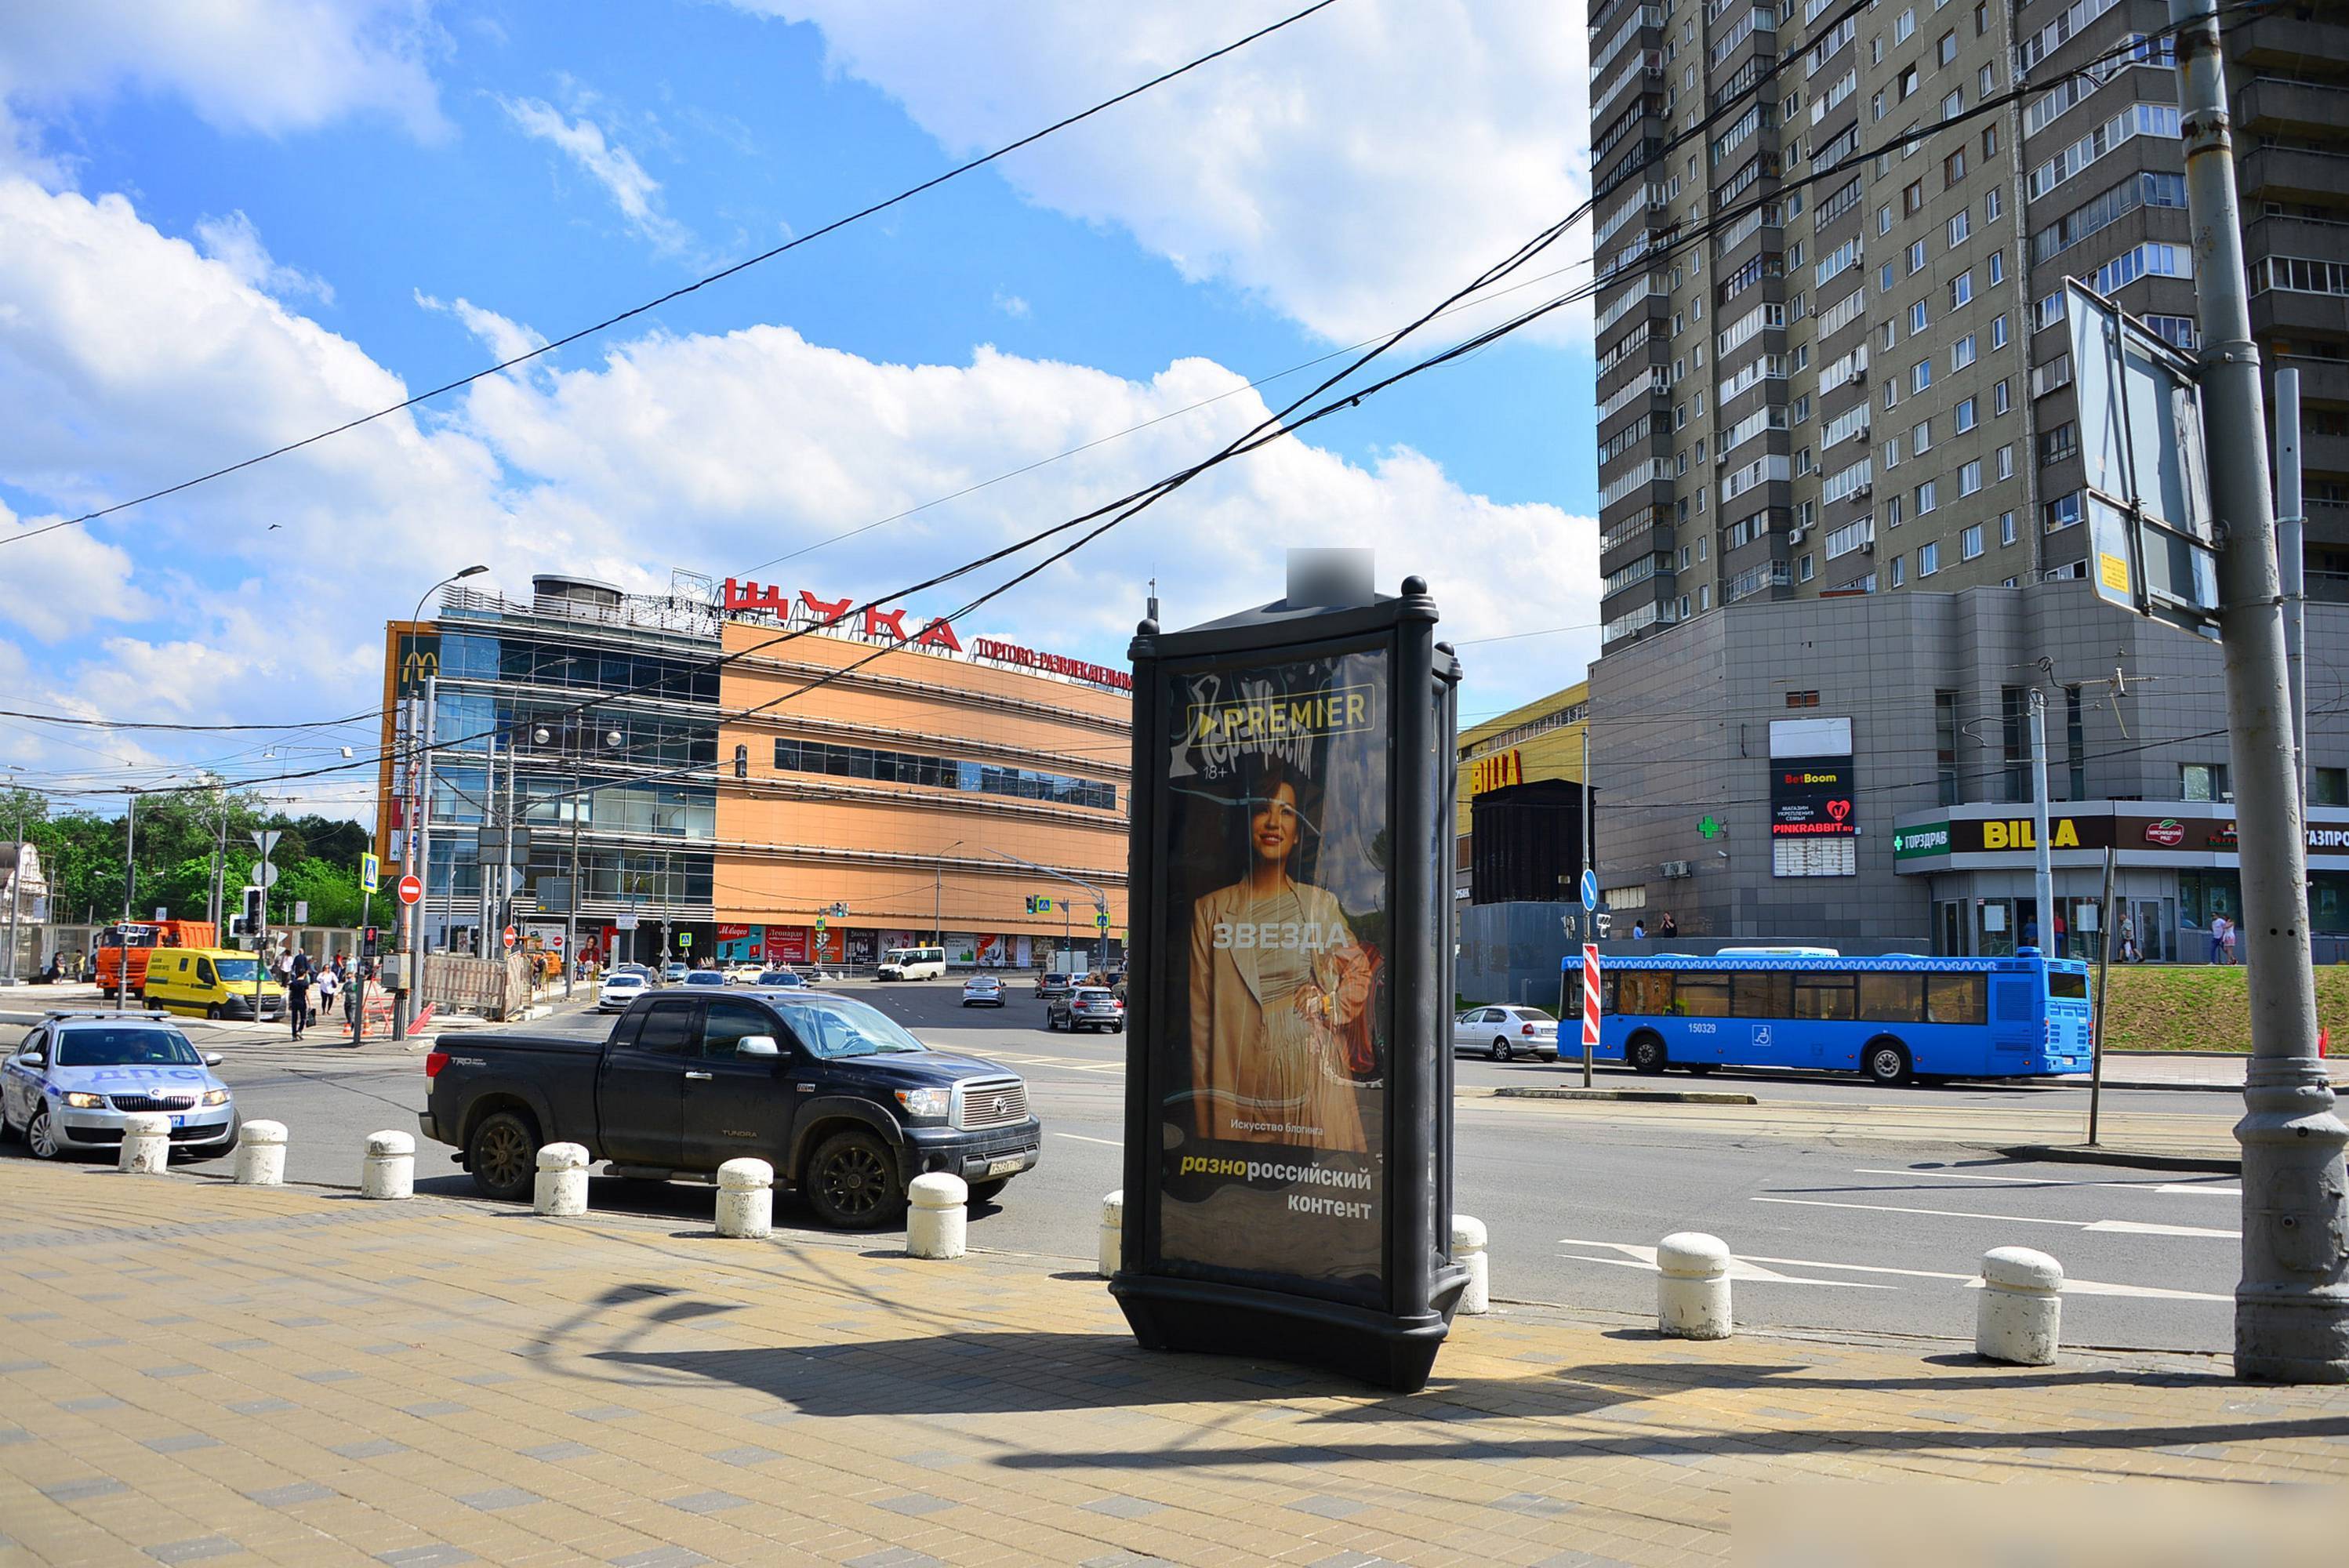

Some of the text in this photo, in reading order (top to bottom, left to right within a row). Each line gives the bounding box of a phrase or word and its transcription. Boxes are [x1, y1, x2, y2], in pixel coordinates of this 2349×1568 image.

[724, 577, 962, 652] ЩУКА
[1224, 693, 1365, 738] PREMIER
[1203, 765, 1229, 780] 18+
[1470, 749, 1523, 795] BILLA
[1784, 773, 1837, 784] BetBoom
[1773, 822, 1853, 834] PINKRABBIT.RU
[1983, 818, 2080, 849] BILA
[1904, 830, 1948, 850] ГОРЗДРАВ
[768, 929, 804, 938] Леонардо
[1212, 920, 1349, 955] ЗВЕЗДА
[1687, 1022, 1716, 1034] 150329
[451, 1056, 472, 1066] TRD
[92, 1068, 201, 1083] ДПС
[722, 1129, 757, 1138] TUNDRA
[1230, 1119, 1324, 1137] Искусство блогинга
[1180, 1154, 1372, 1191] разнороссийский
[1287, 1193, 1372, 1221] контент
